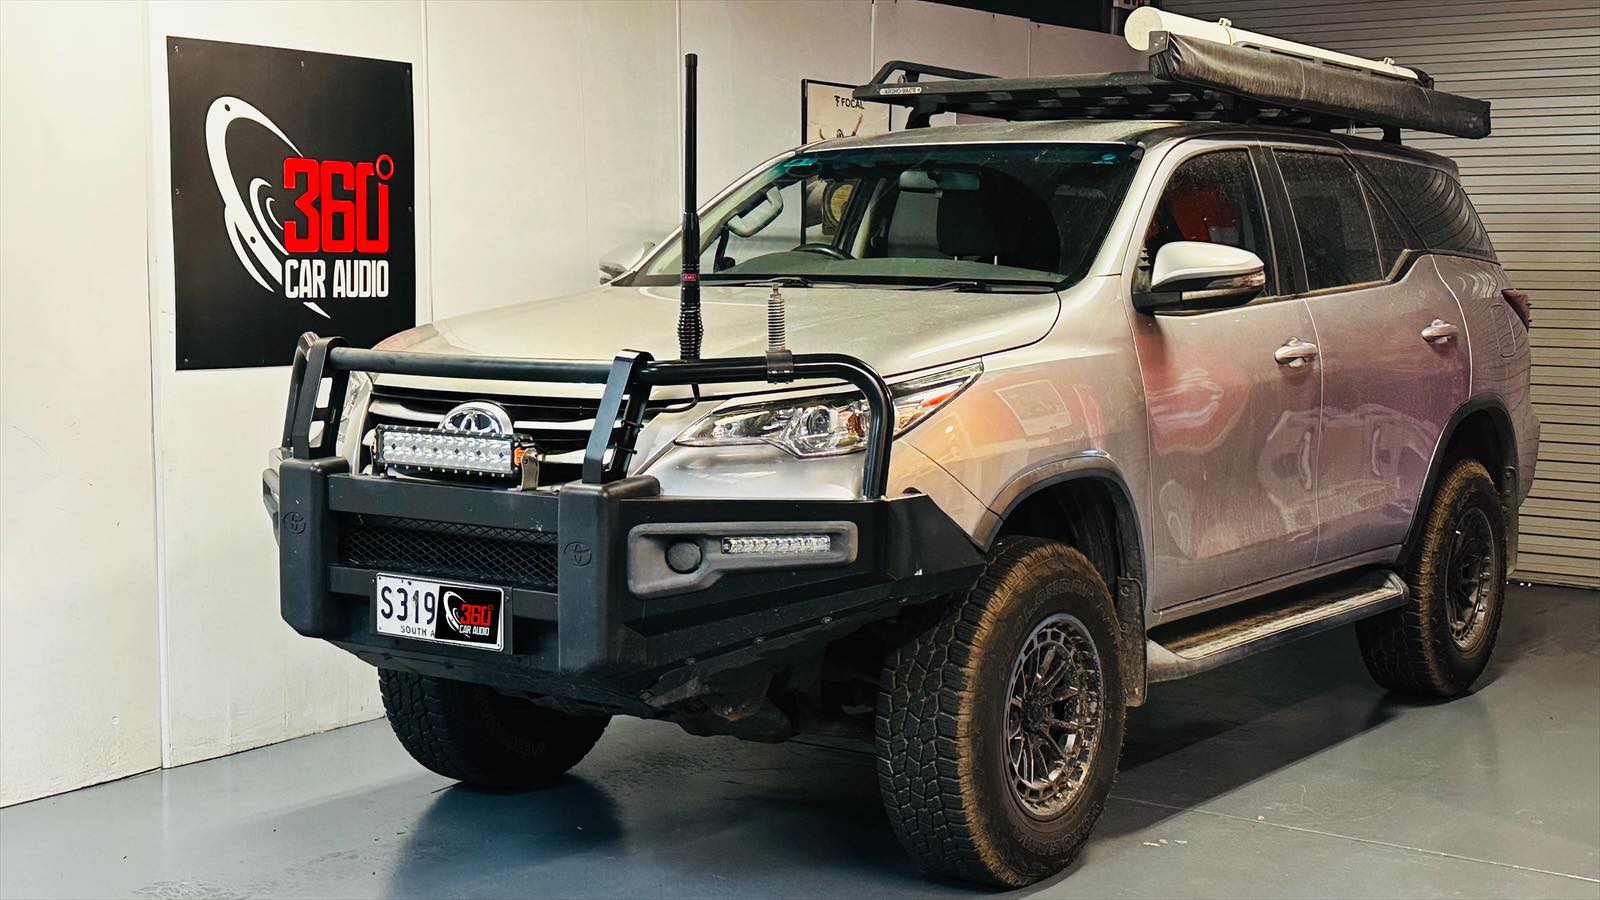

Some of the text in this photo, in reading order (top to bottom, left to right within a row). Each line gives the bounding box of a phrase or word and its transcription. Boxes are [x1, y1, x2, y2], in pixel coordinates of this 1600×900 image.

[841, 98, 865, 110] FOCAL
[285, 259, 389, 298] CAR AUDIO
[381, 586, 436, 625] S319
[400, 625, 427, 635] SOUTH
